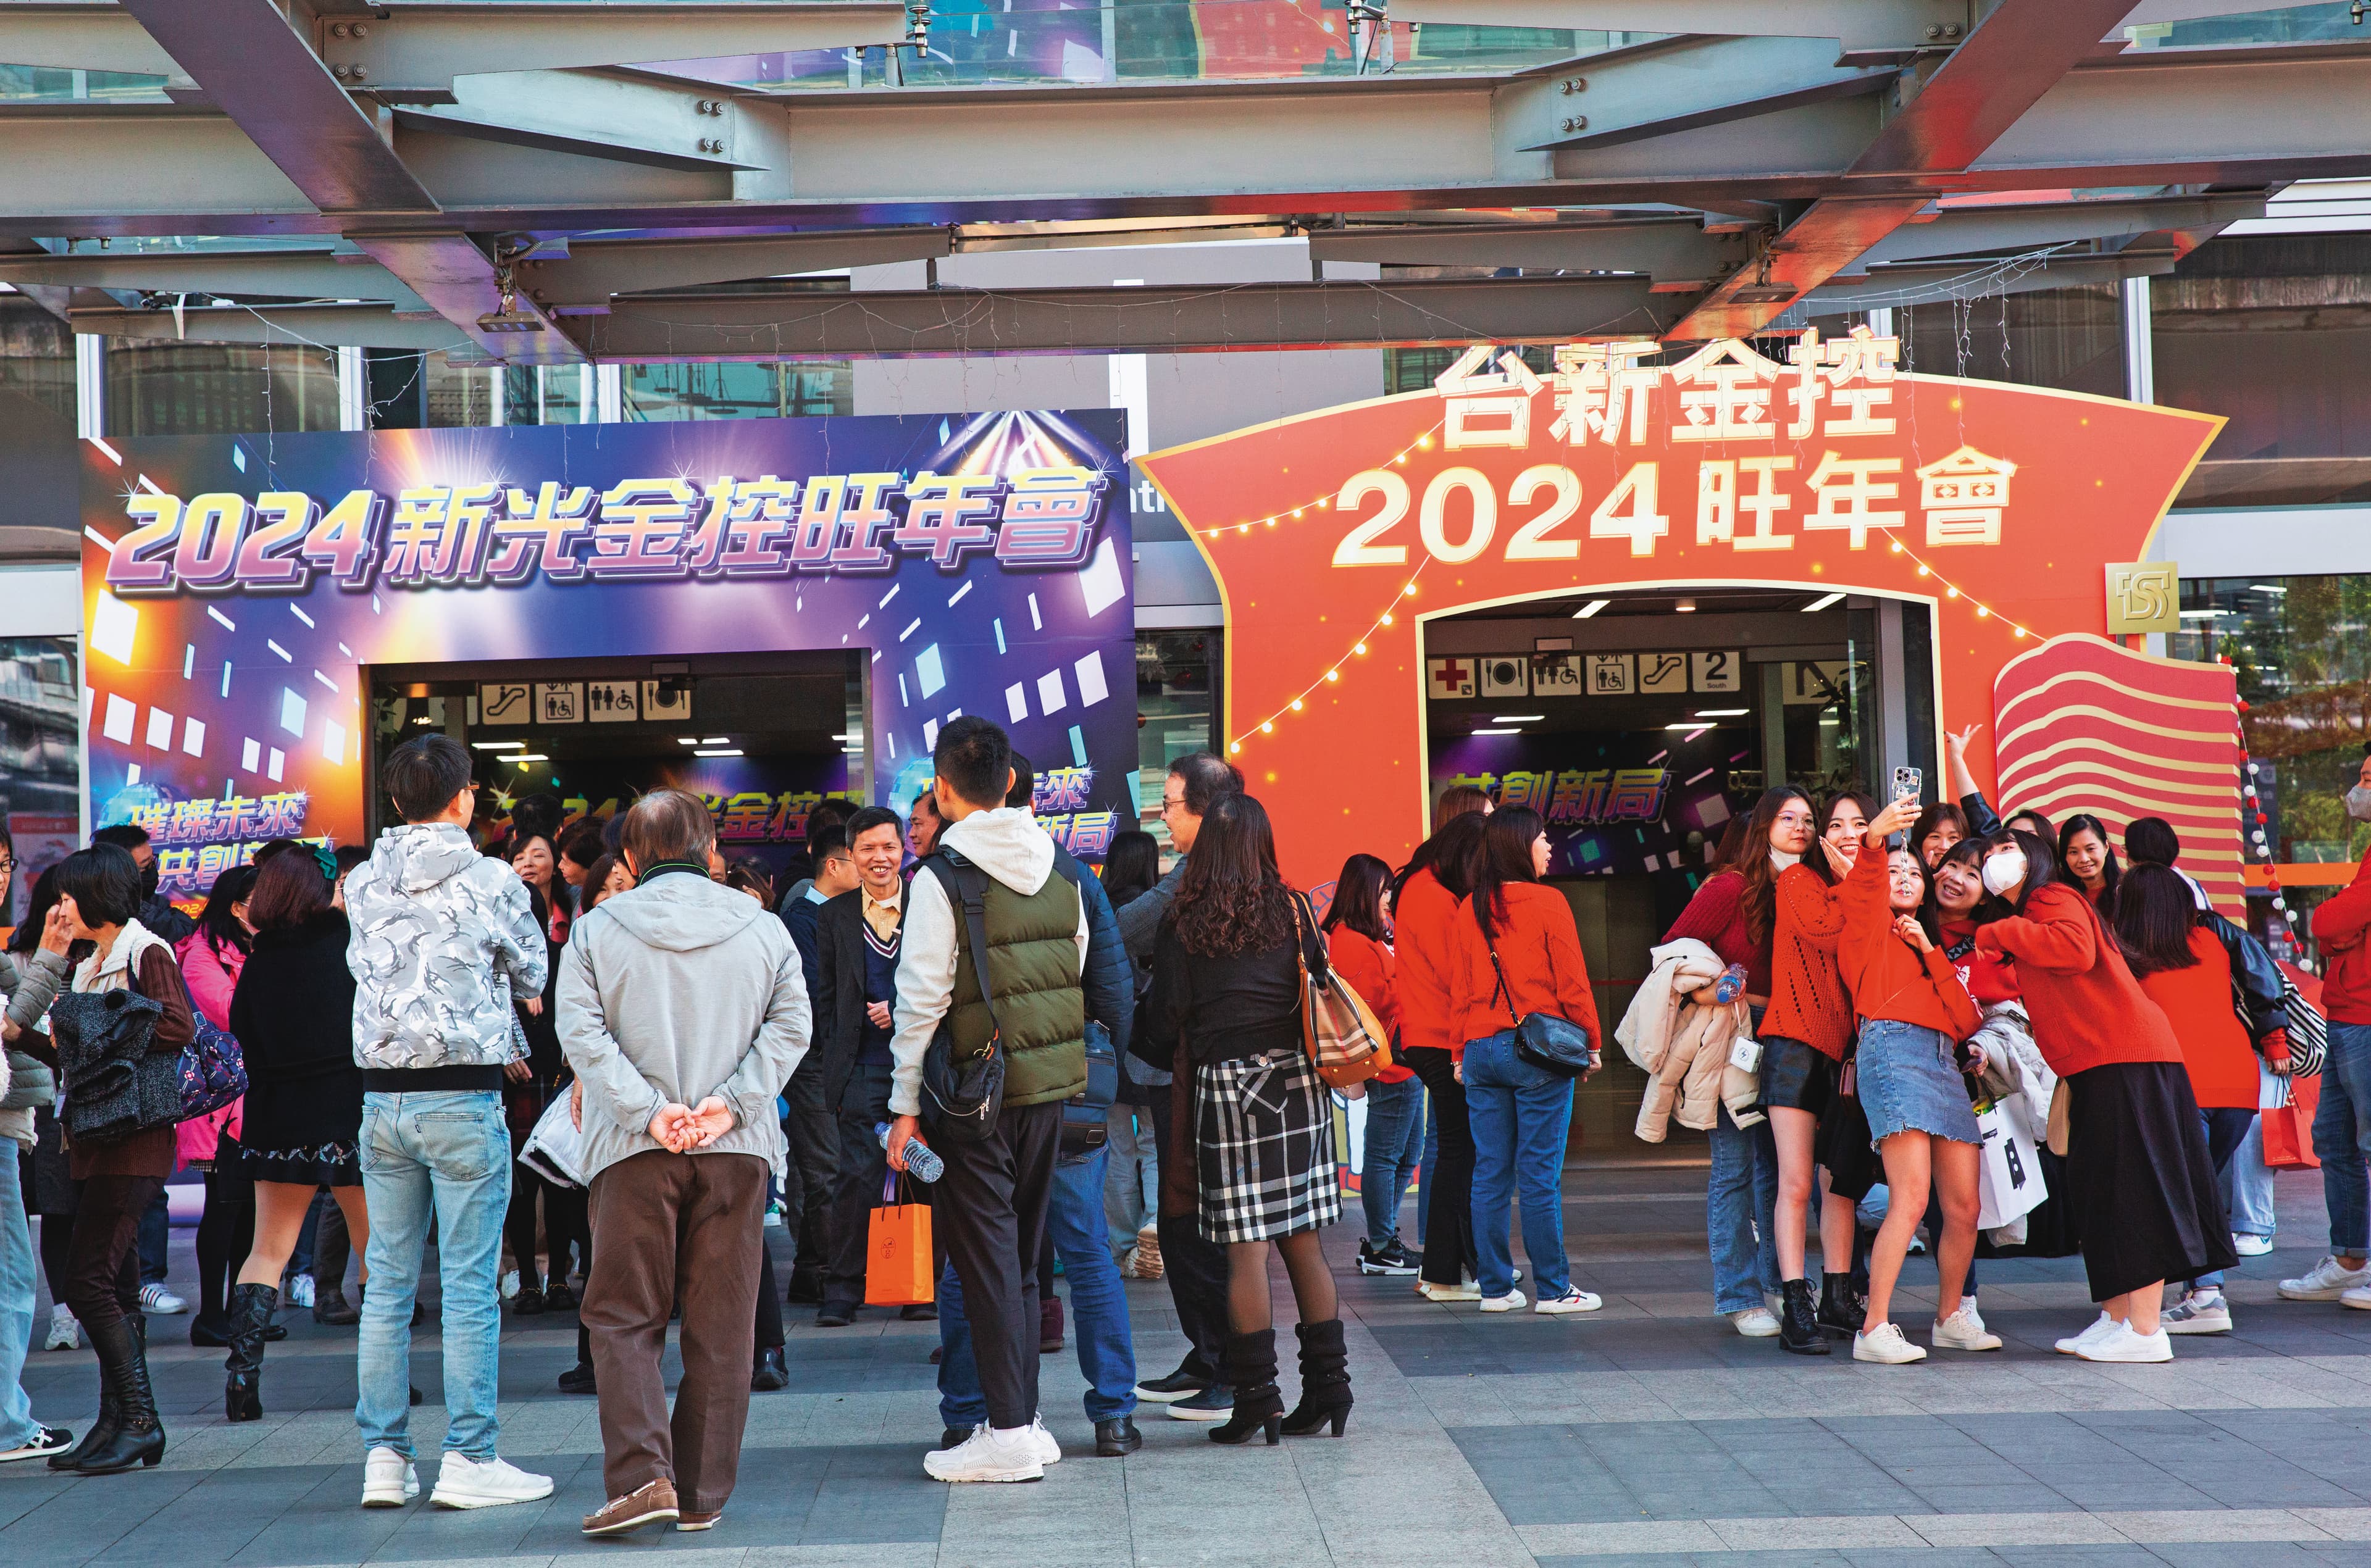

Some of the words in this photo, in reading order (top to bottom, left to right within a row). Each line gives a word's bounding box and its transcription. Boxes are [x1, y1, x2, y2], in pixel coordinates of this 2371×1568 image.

[1434, 325, 1899, 451] 台新金控
[106, 465, 1106, 591] 2024新光金控旺年會
[1331, 461, 1669, 568] 2024
[1696, 444, 2018, 551] 旺年會
[1705, 652, 1728, 680] 2
[129, 792, 305, 845] 璀璨未來
